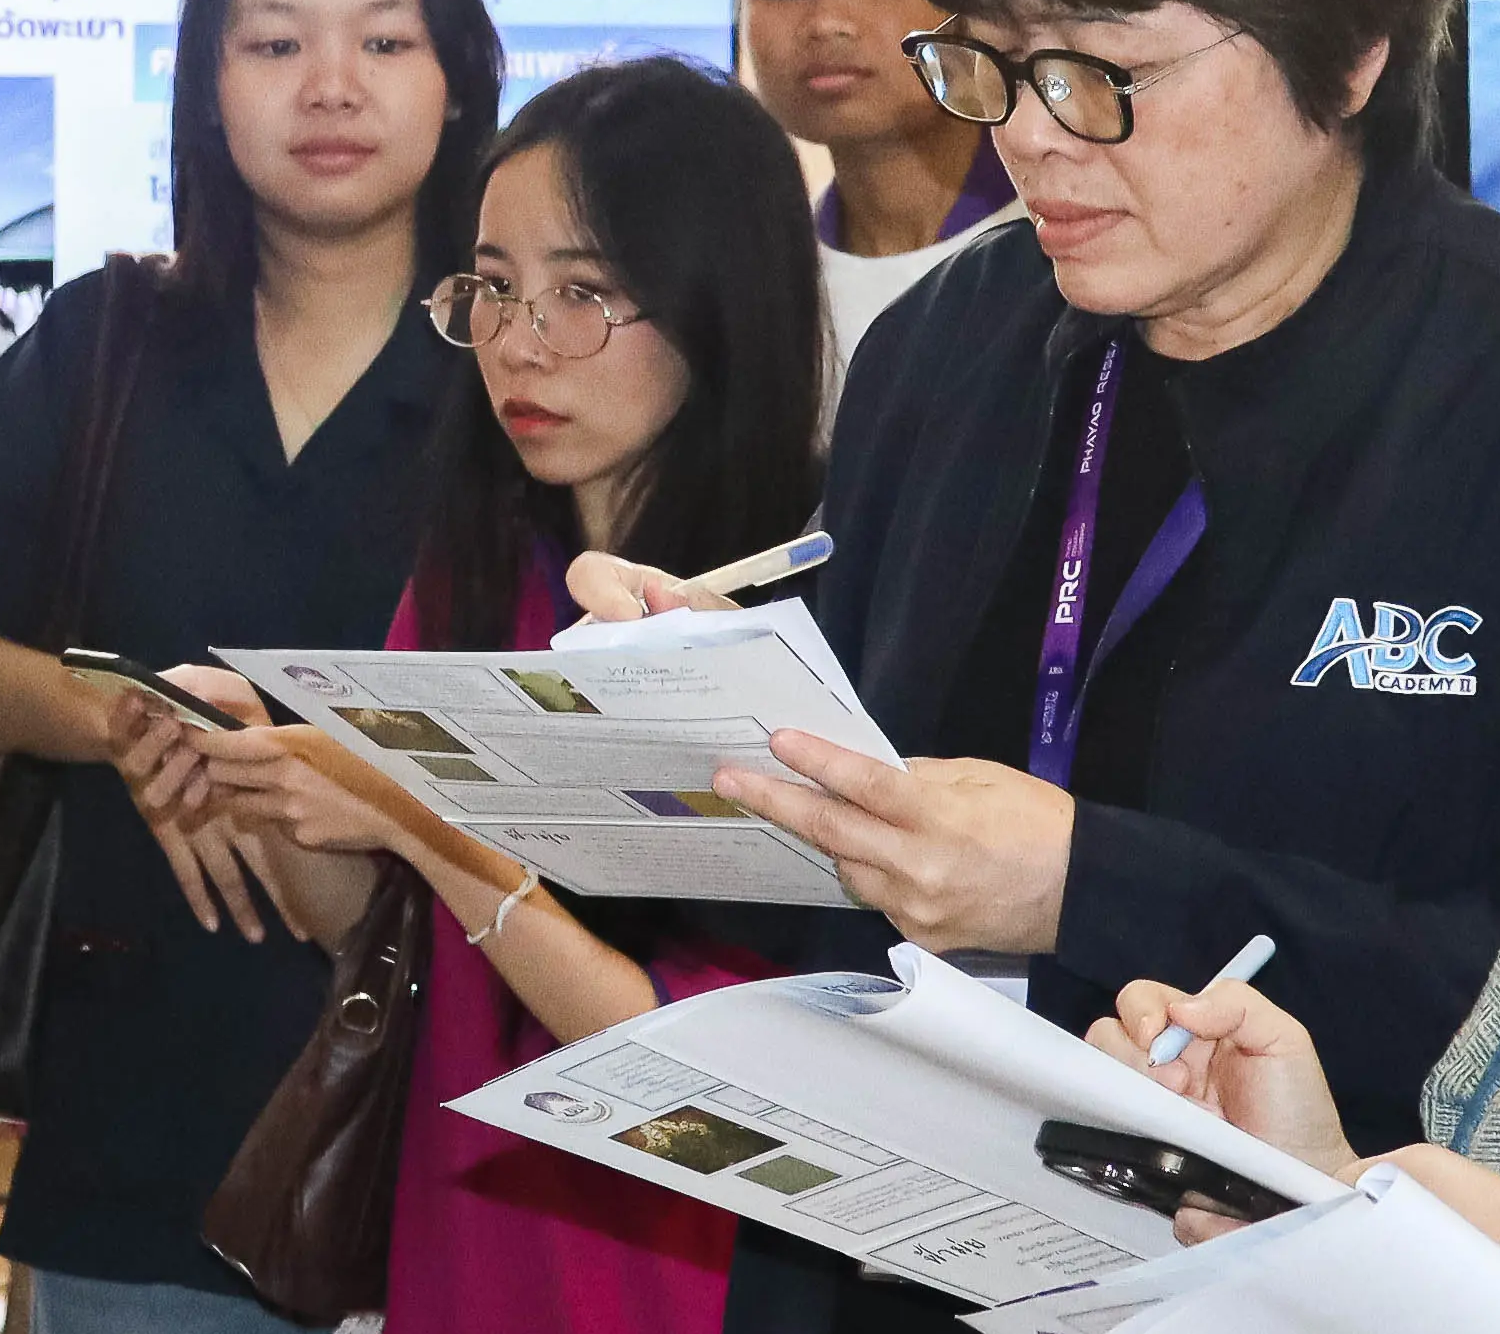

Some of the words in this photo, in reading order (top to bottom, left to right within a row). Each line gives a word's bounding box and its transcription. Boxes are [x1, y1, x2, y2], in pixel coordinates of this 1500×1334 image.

[1080, 402, 1102, 474] PHAYAO
[1054, 560, 1082, 624] PRC
[1290, 598, 1484, 690] ABC
